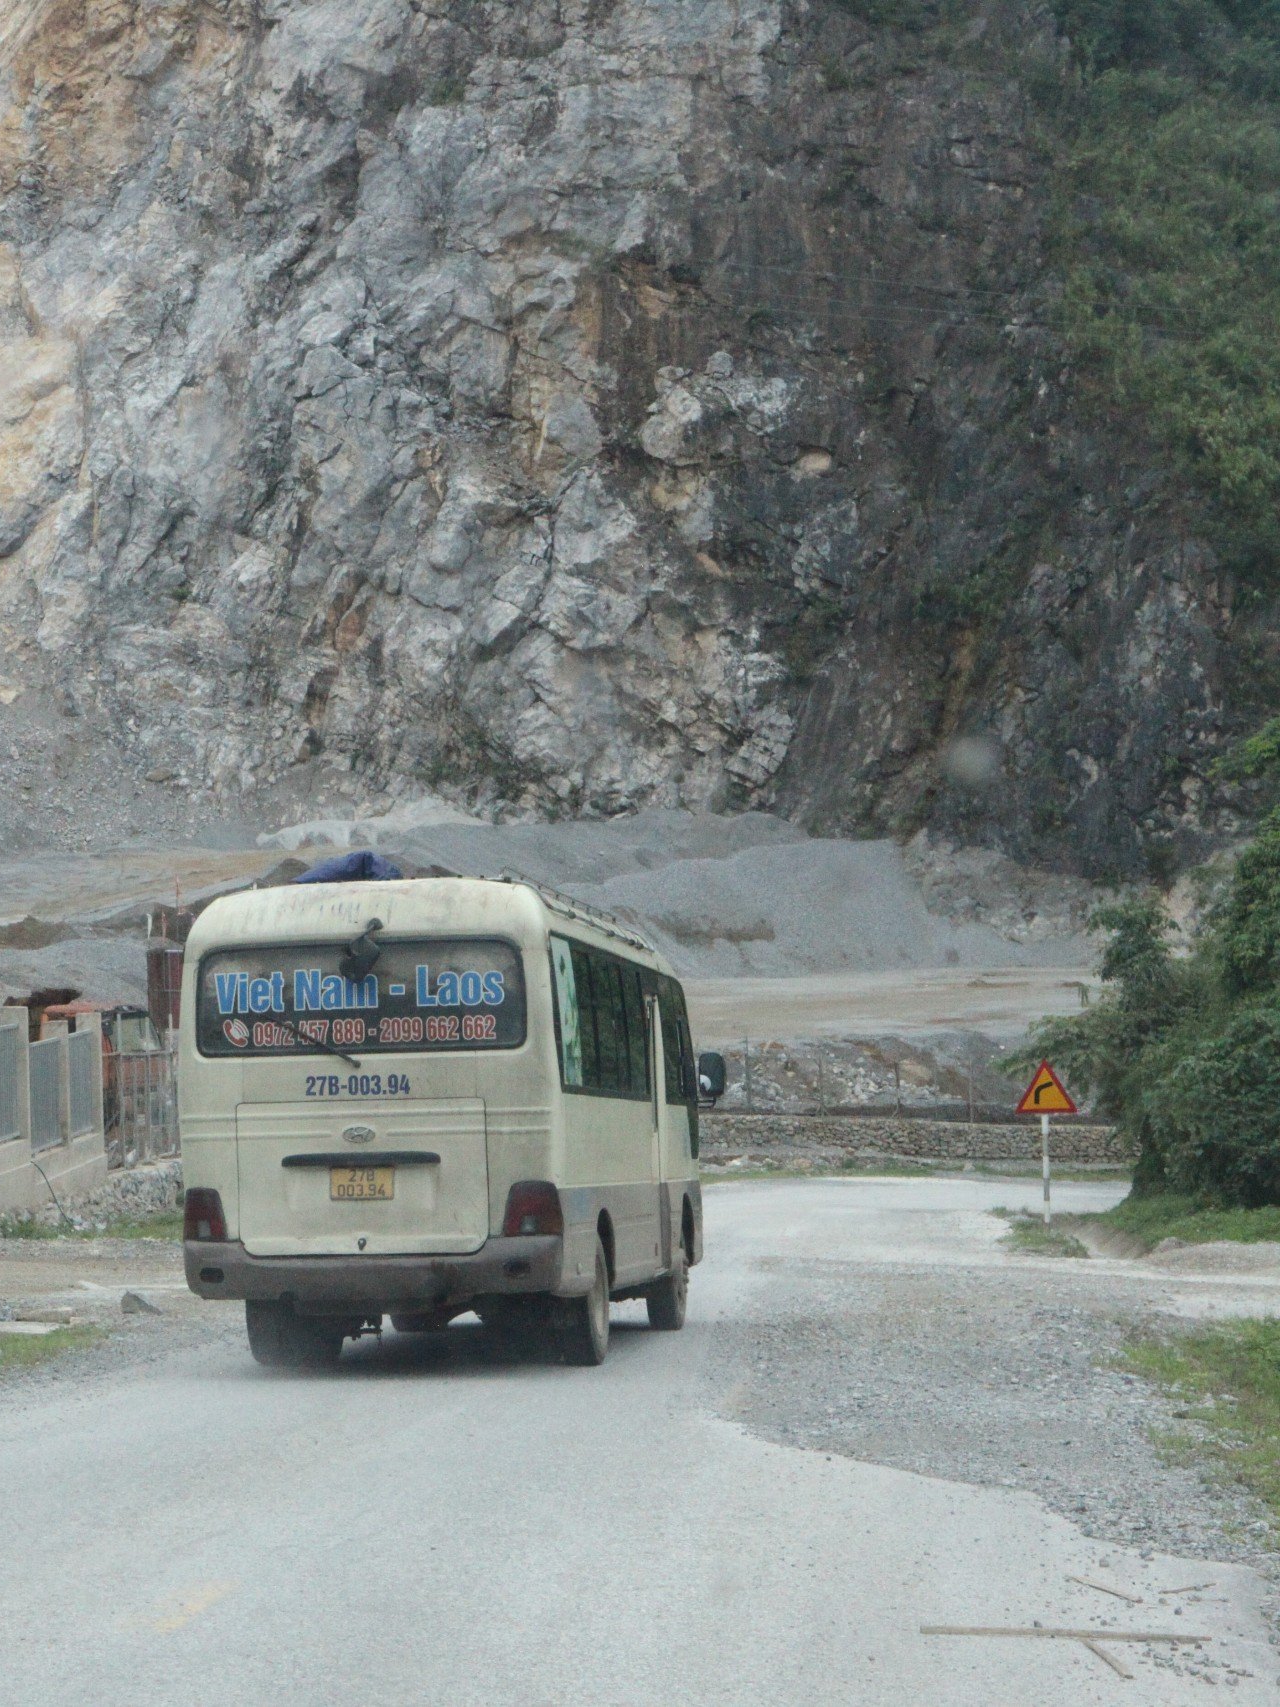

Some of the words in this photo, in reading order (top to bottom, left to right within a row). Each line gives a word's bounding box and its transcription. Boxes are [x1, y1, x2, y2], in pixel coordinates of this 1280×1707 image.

[215, 972, 285, 1014] Viet
[294, 969, 379, 1011] Nam
[416, 965, 505, 1007] Laos
[253, 1022, 294, 1046] 0972
[332, 1018, 365, 1044] 889
[379, 1016, 423, 1042] 2099
[426, 1016, 459, 1040] 662
[462, 1015, 496, 1040] 662
[305, 1074, 410, 1096] 27B-003.94
[349, 1168, 375, 1182] 27B
[337, 1183, 385, 1197] 003.94
